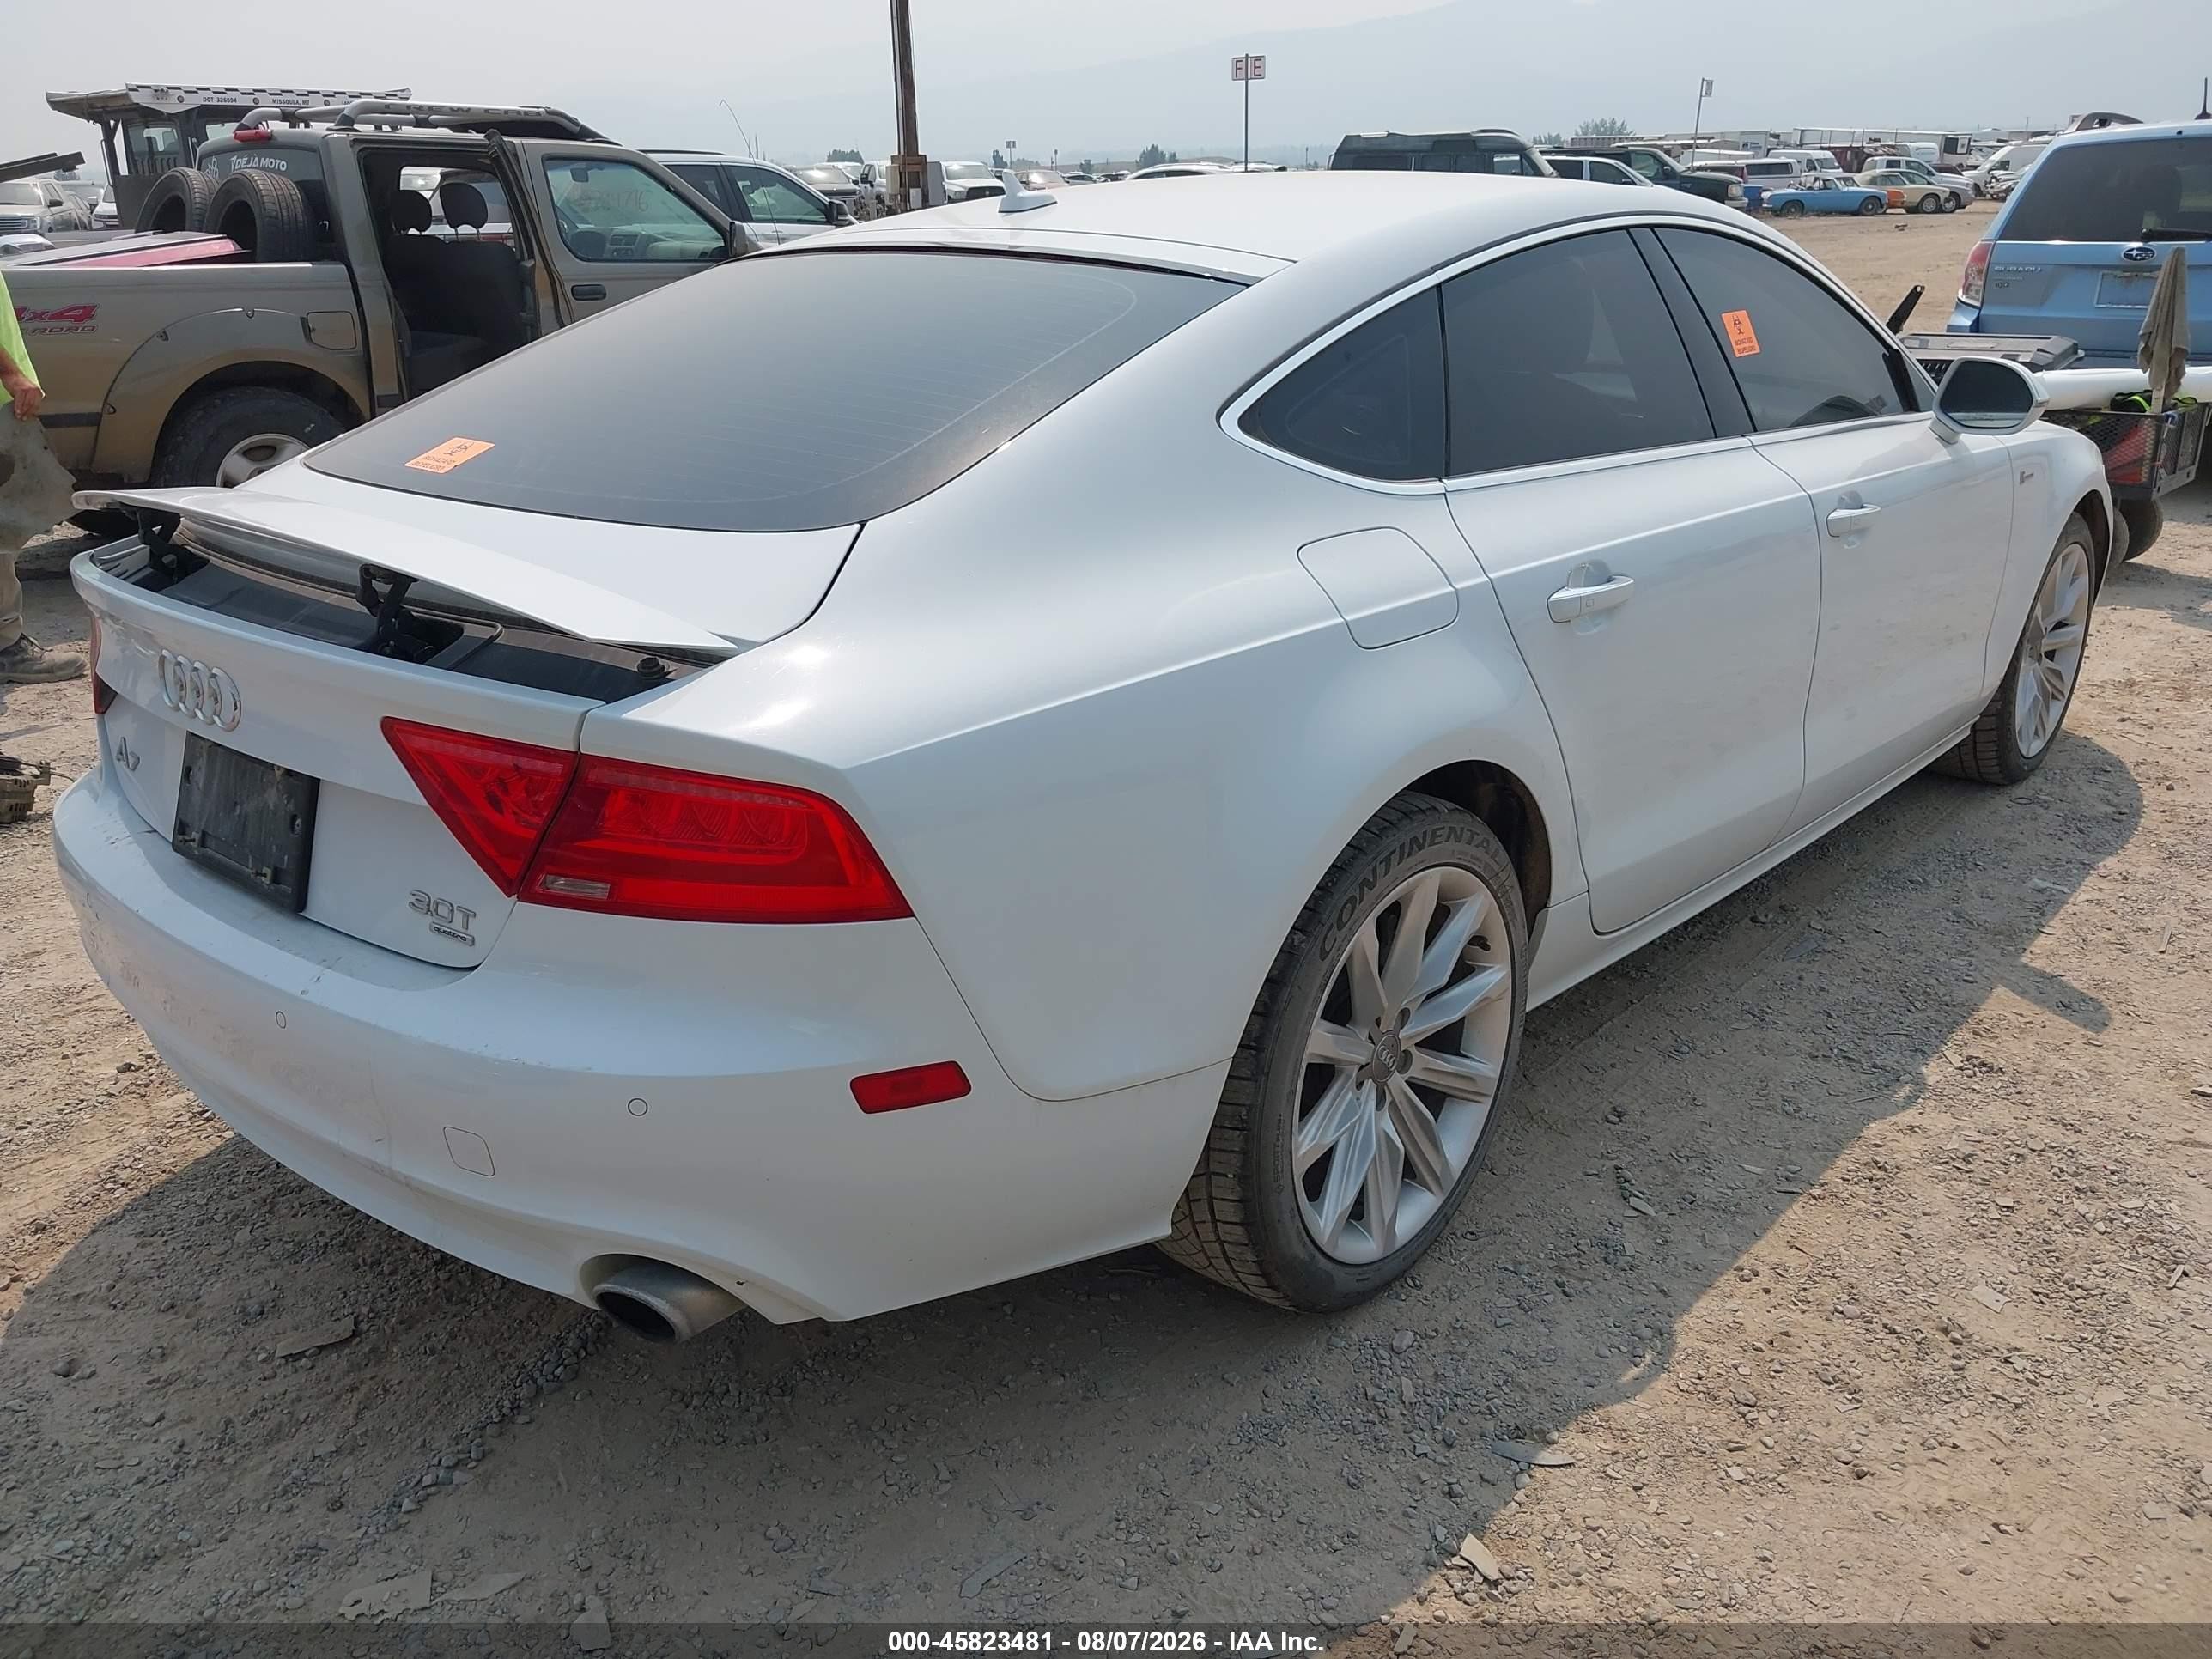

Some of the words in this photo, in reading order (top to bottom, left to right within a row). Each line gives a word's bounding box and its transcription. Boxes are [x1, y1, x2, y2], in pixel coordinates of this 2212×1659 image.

[1235, 59, 1243, 78] F
[1254, 58, 1262, 77] E
[115, 736, 141, 772] A7
[1319, 825, 1509, 962] CONTINENTAL
[433, 926, 467, 942] quattro
